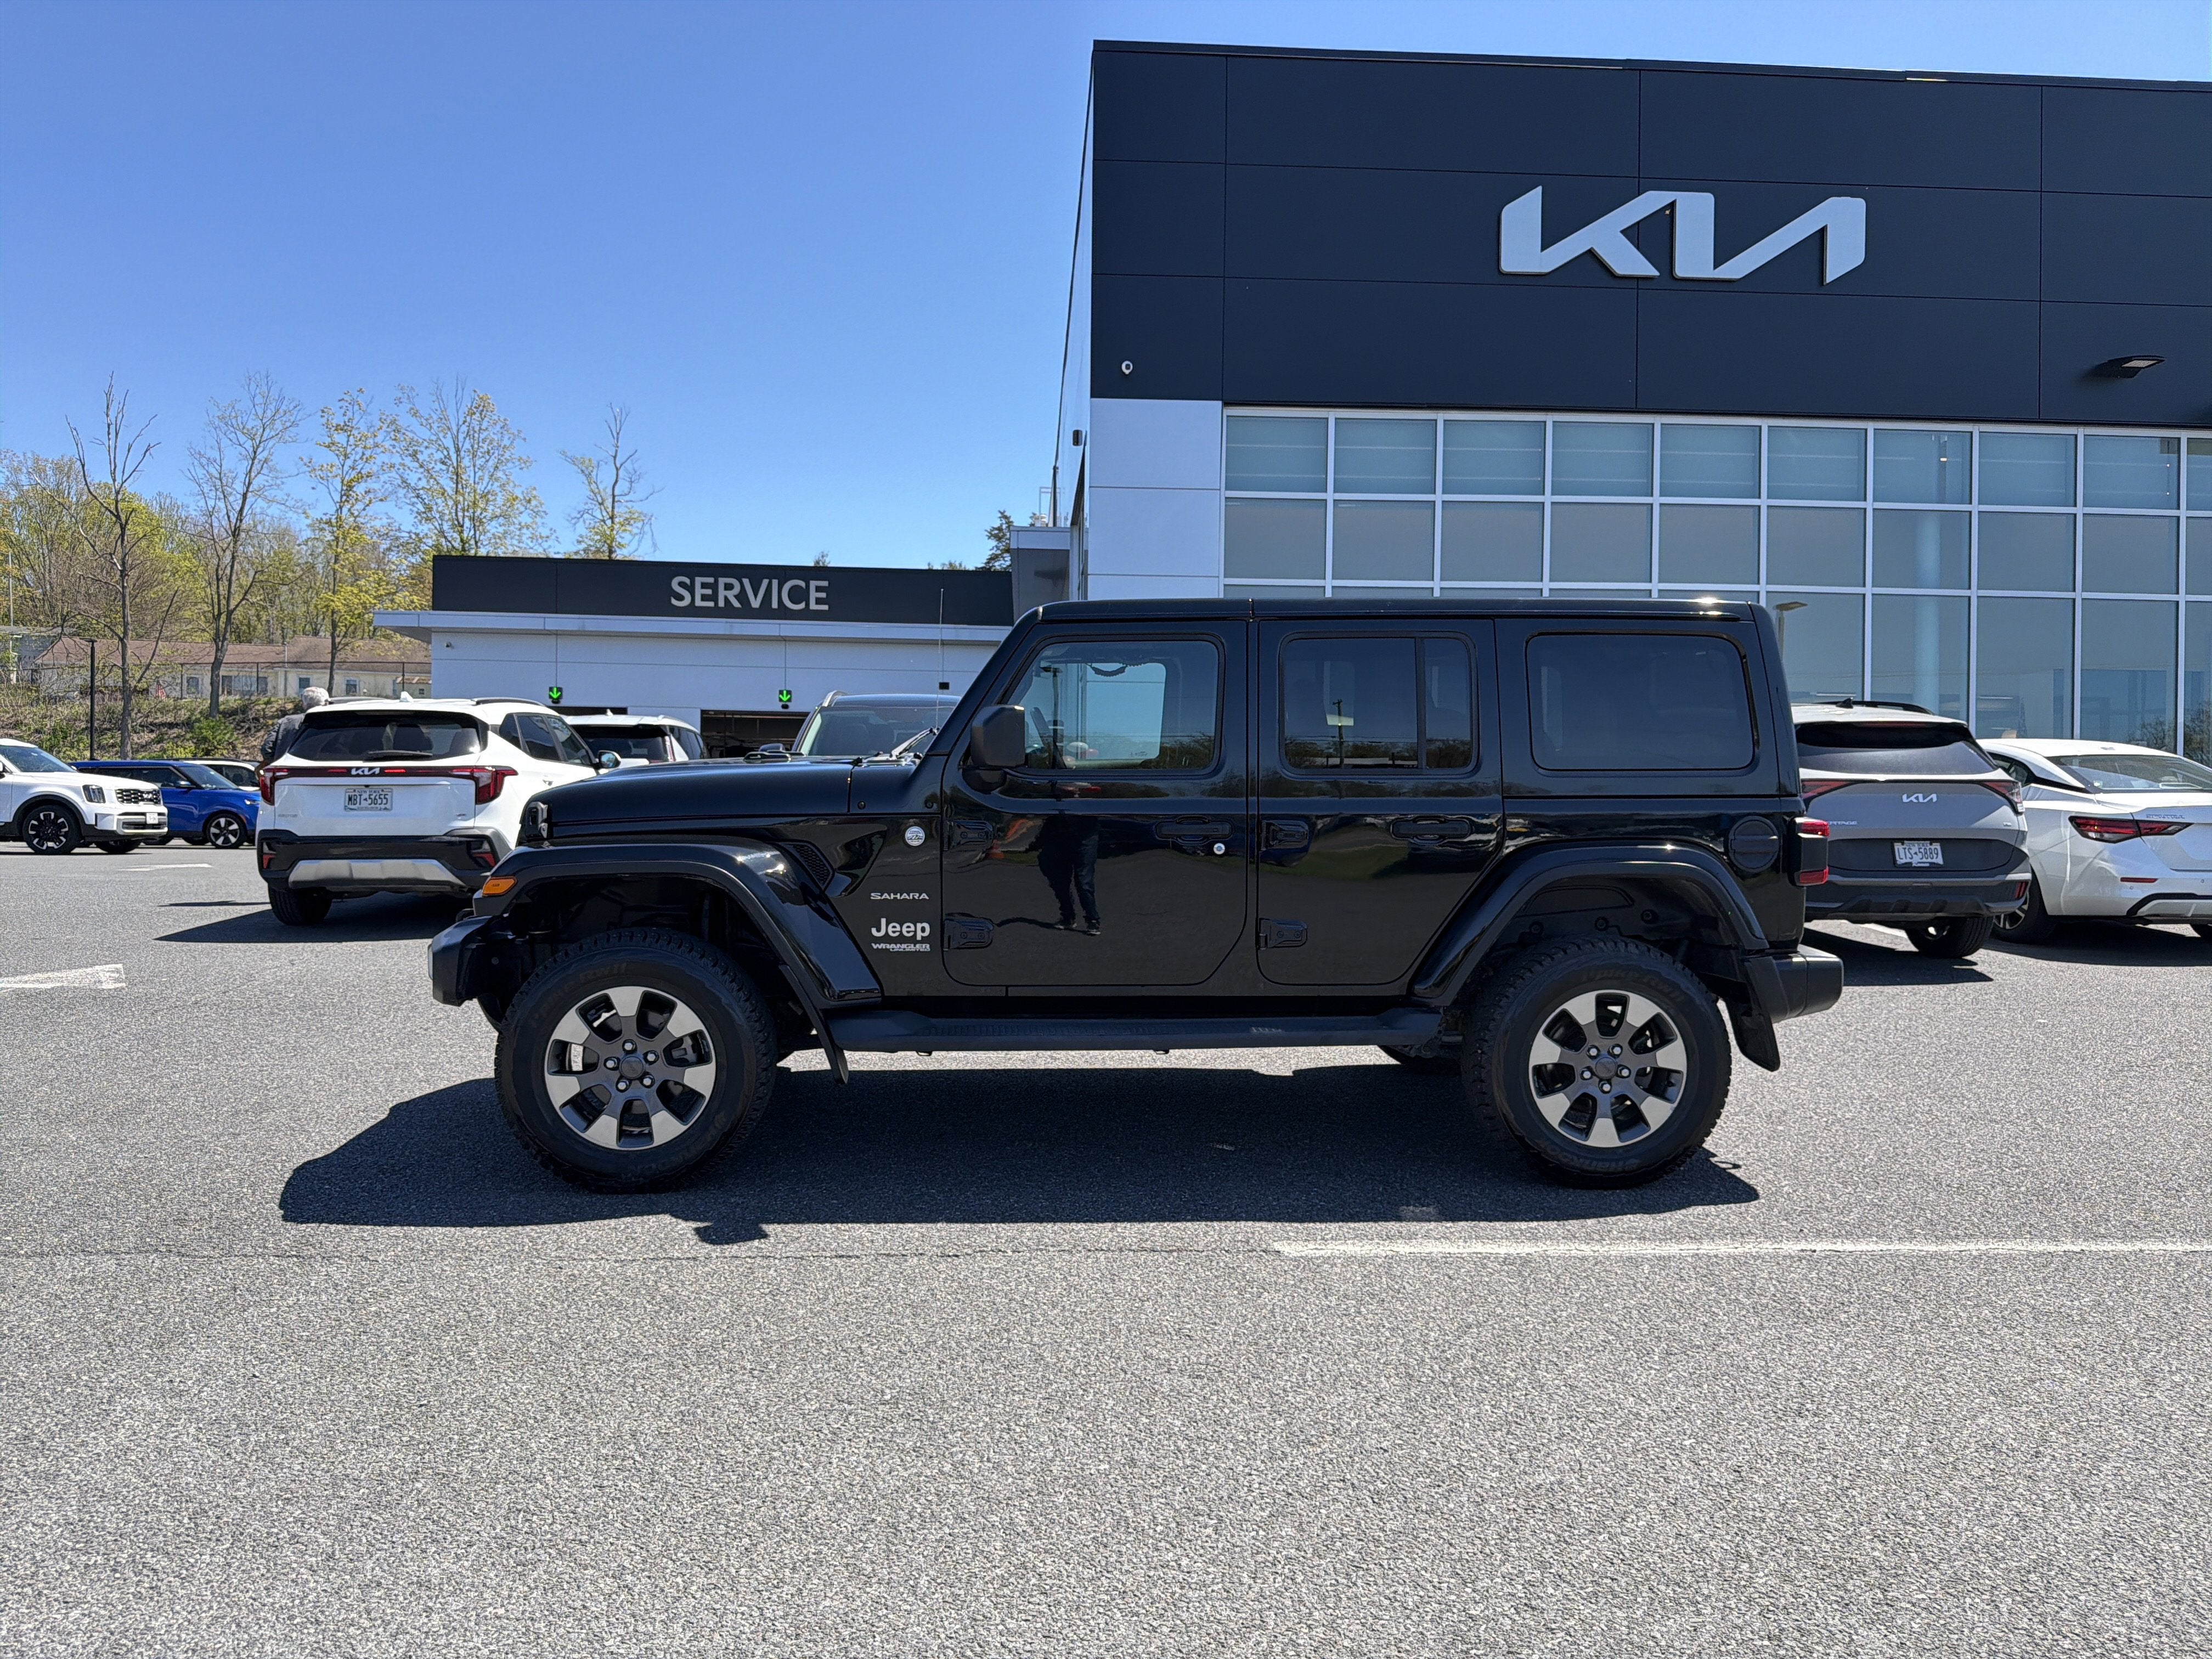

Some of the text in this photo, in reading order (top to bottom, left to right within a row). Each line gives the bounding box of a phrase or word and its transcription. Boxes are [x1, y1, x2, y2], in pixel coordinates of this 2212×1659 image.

[1500, 185, 1866, 285] KIA
[671, 576, 829, 611] SERVICE
[1902, 793, 1937, 803] KIA
[871, 917, 930, 941] Jeep
